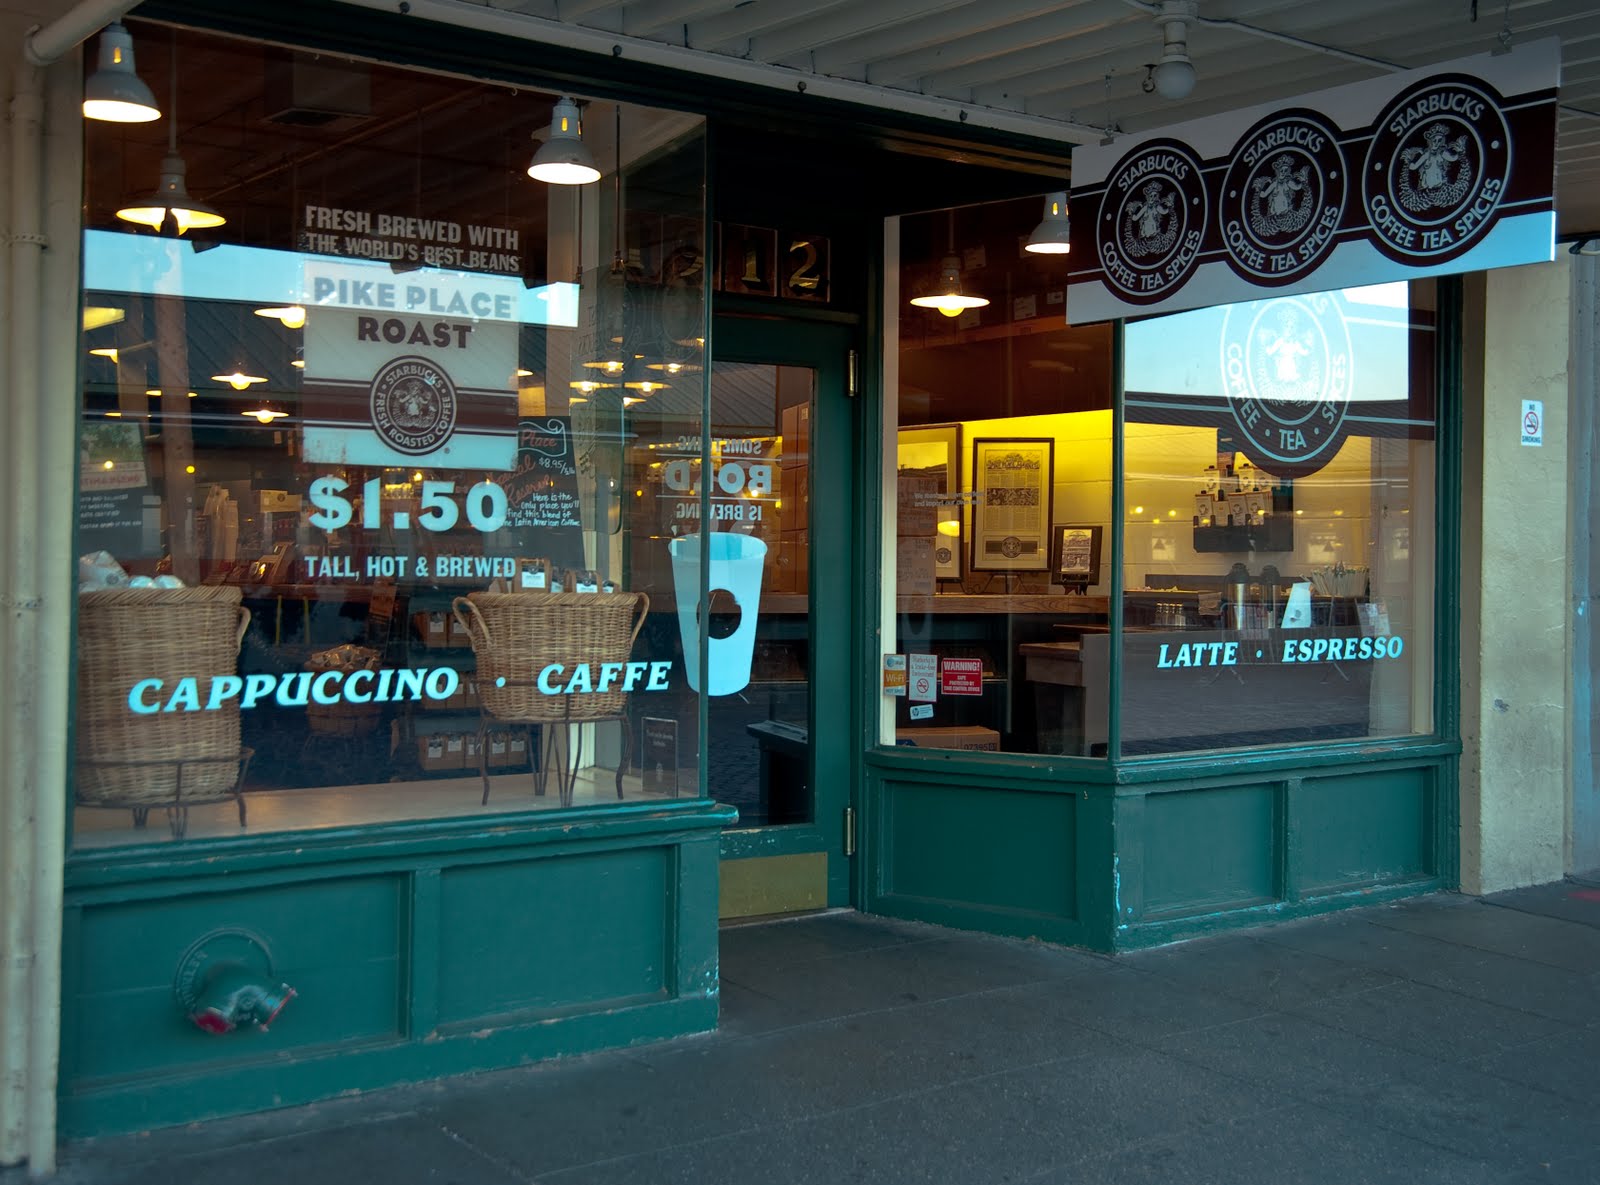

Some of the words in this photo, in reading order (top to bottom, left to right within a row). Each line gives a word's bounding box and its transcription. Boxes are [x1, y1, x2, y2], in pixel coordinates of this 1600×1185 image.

[1390, 92, 1485, 137] STARBUCKS
[1243, 126, 1325, 167] STARBUCKS
[1117, 154, 1189, 192] STARBUCKS
[305, 204, 371, 234] FRESH
[377, 215, 461, 244] BREWED
[468, 224, 519, 251] WITH
[1371, 194, 1416, 247] COFFEE
[1421, 228, 1453, 249] TEA
[1454, 177, 1501, 237] SPICES
[306, 232, 339, 255] THE
[345, 236, 419, 263] WORLD'S
[424, 246, 464, 267] BEST
[469, 250, 521, 272] BEANS
[1226, 220, 1266, 270] COFFEE
[1270, 251, 1298, 272] TEA
[1298, 205, 1339, 261] SPICES
[1103, 241, 1137, 288] COFFEE
[1140, 272, 1165, 291] TEA
[1165, 230, 1200, 281] SPICES
[313, 276, 396, 308] PIKE
[406, 285, 512, 319] PLACE
[357, 316, 473, 349] ROAST
[385, 364, 444, 389] STARBUCKS
[1227, 343, 1261, 429] COFFEE
[1278, 428, 1307, 450] TEA
[1322, 352, 1346, 425] SPICES
[375, 392, 391, 429] FRESH
[388, 428, 436, 447] ROASTED
[435, 396, 452, 436] COFFEE
[520, 428, 558, 449] Place
[308, 474, 508, 534] $1.50
[540, 501, 560, 512] place
[558, 492, 573, 501] the
[304, 555, 360, 581] TALL,
[367, 556, 408, 577] HOT
[415, 556, 429, 577] &
[436, 556, 516, 578] BREWED
[943, 661, 980, 671] WARNING!
[1157, 641, 1239, 668] LATTE
[1281, 636, 1403, 662] ESPRESSO
[128, 667, 460, 714] CAPPUCCINO
[537, 661, 673, 695] CAFFE
